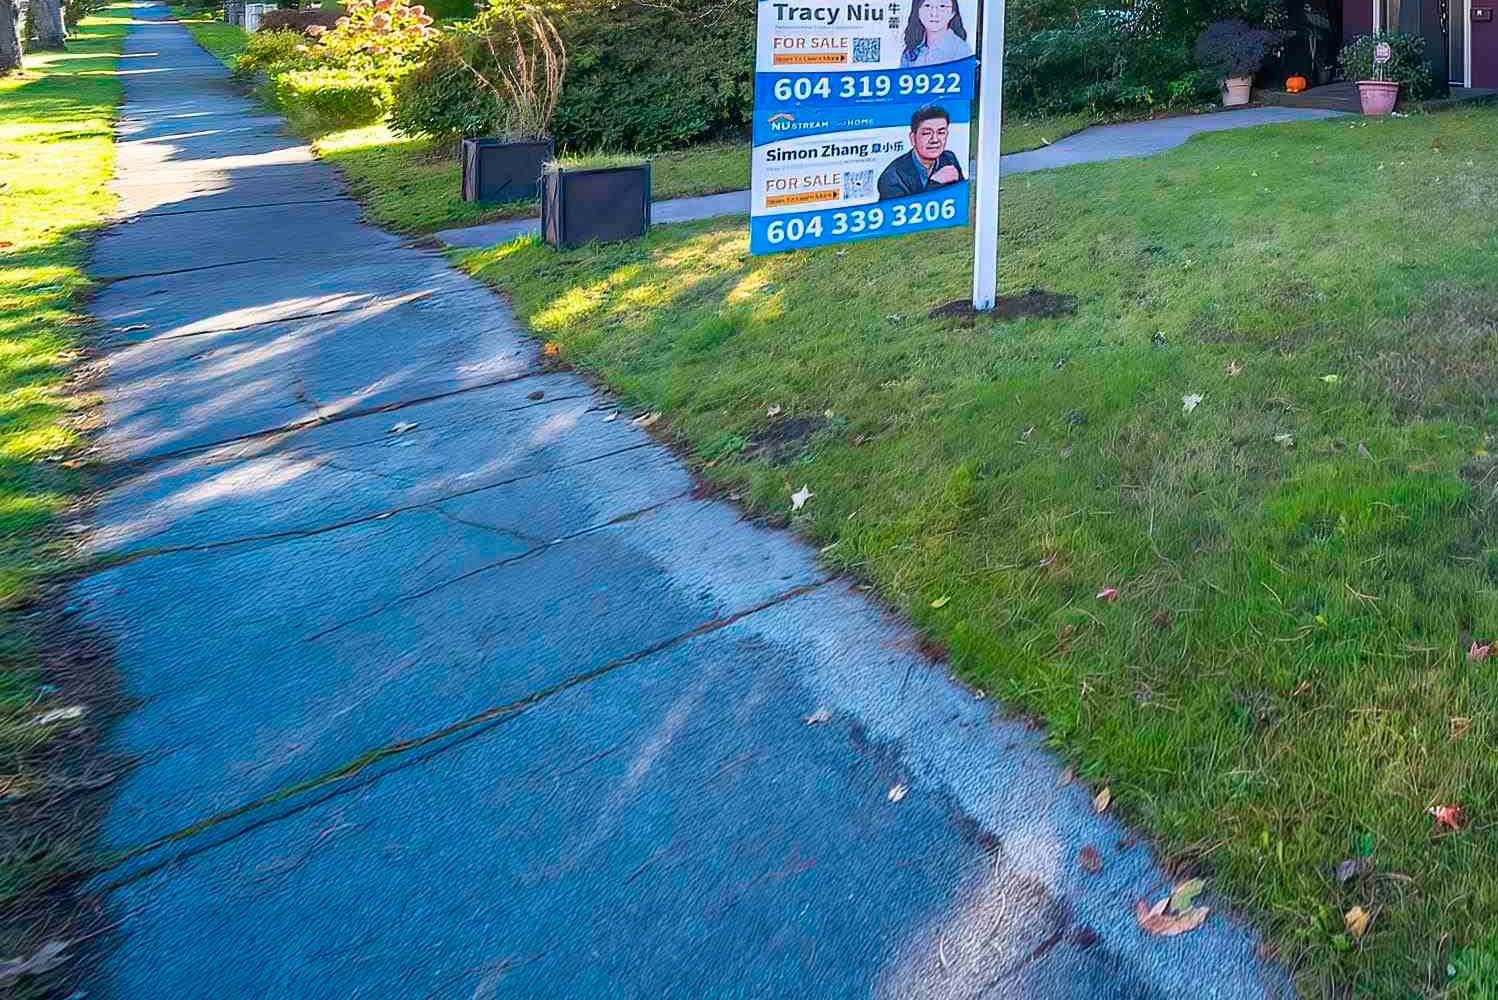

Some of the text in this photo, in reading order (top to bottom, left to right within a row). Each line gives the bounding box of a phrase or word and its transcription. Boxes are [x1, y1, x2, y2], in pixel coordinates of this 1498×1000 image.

[773, 3, 884, 25] Tracy Niu
[773, 37, 849, 49] FOR SALE
[774, 72, 961, 102] 604 319 9922
[766, 143, 869, 161] Simon Zhang
[766, 173, 841, 192] FOR SALE
[767, 199, 956, 243] 604 339 3206
